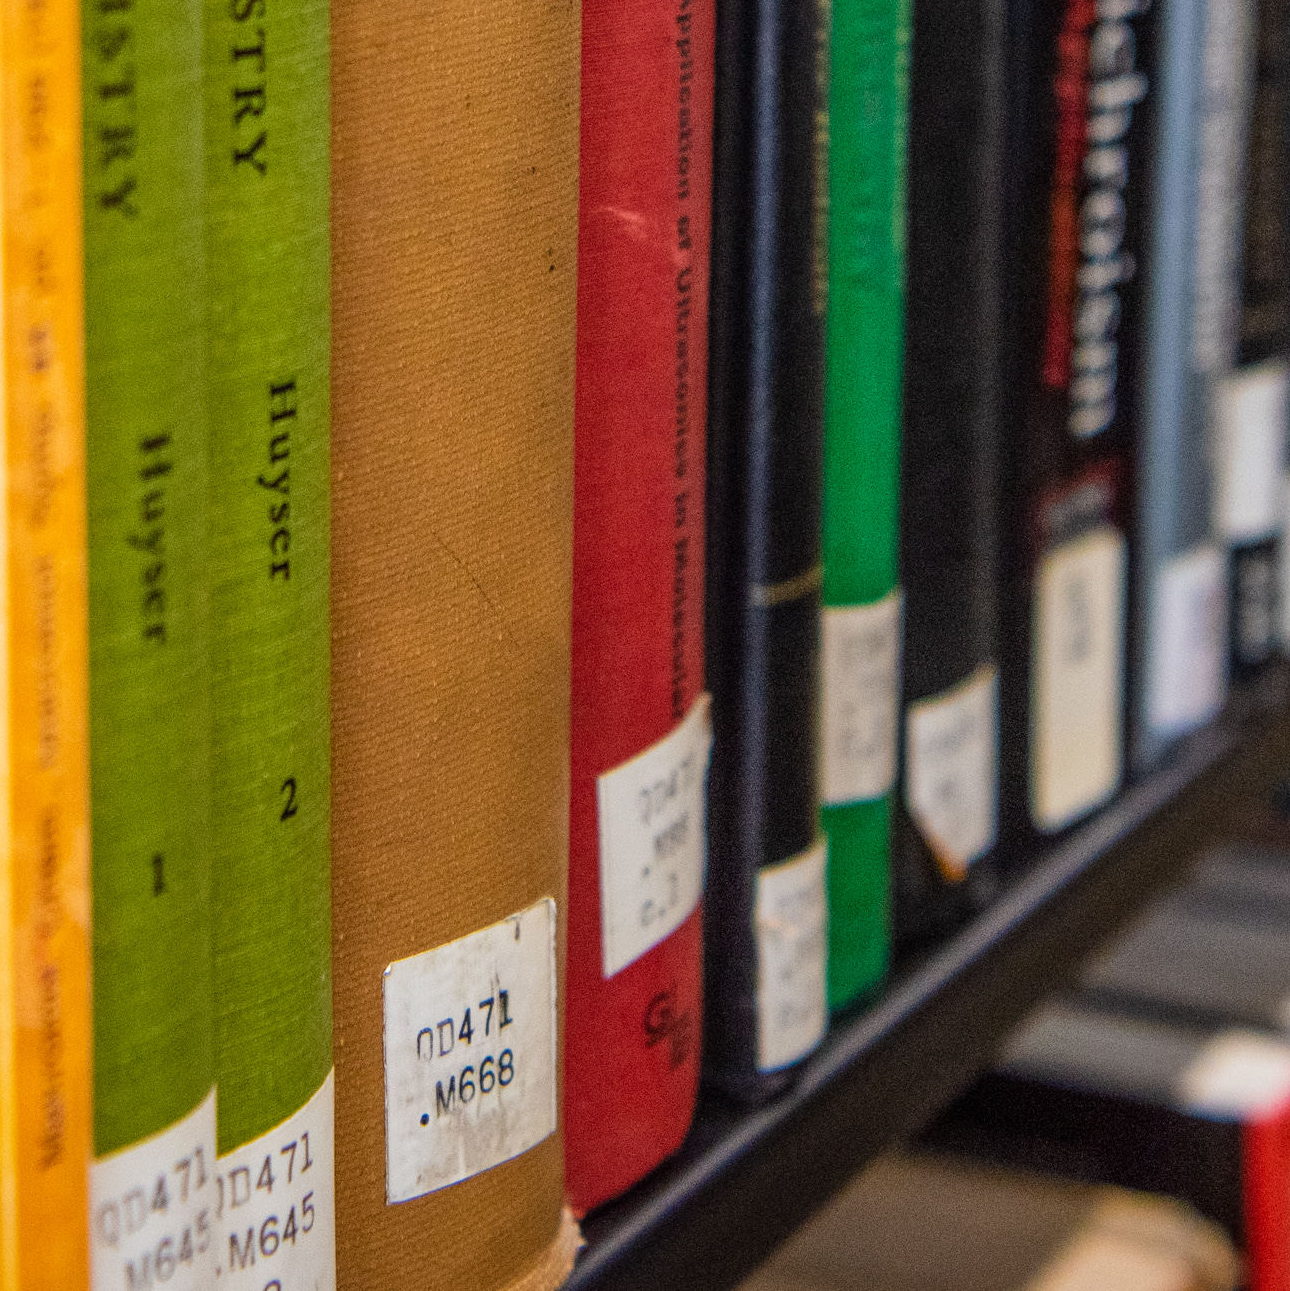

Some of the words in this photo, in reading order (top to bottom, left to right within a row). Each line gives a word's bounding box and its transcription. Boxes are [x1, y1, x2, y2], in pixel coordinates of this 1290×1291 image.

[257, 377, 298, 581] Huyser
[125, 433, 175, 647] Huyser
[279, 776, 299, 822] 2
[151, 852, 167, 898] 1
[419, 1048, 515, 1127] .M668
[215, 1190, 316, 1278] .M645
